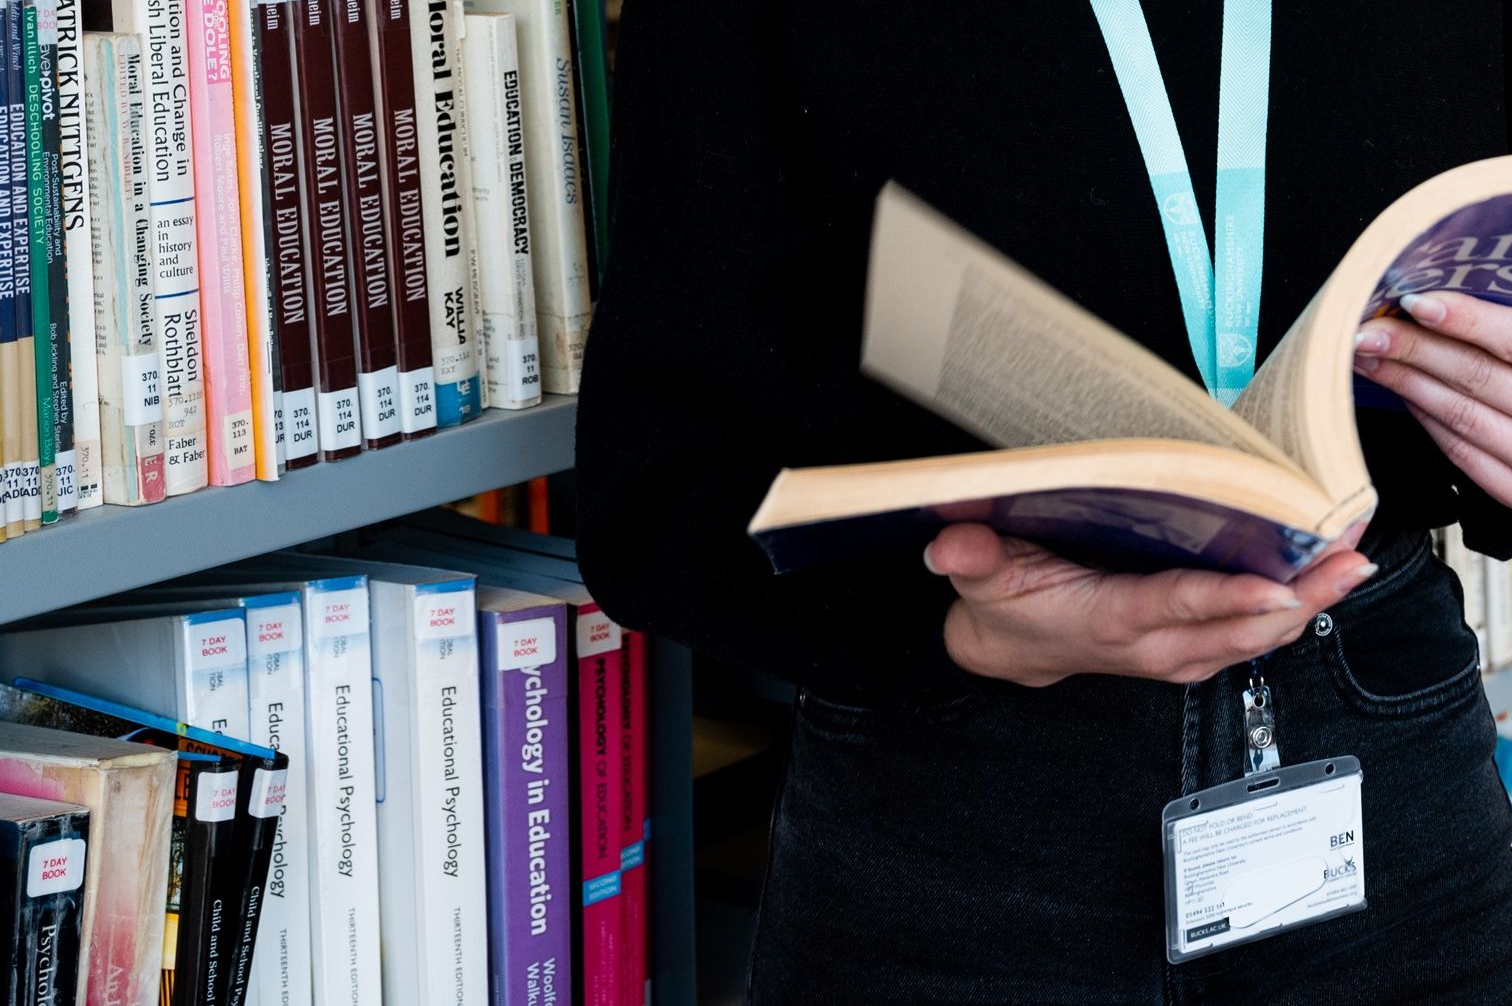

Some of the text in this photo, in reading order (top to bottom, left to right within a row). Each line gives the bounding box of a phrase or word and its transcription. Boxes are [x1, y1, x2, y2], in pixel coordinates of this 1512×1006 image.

[149, 24, 168, 87] Liberal
[171, 44, 182, 78] and
[203, 12, 219, 81] DOLE?
[26, 11, 45, 245] Ivan Illich DESCHOOLING SOCIETY
[173, 84, 187, 152] Change
[503, 69, 523, 157] EDUCATION
[556, 57, 577, 205] Susan Isaacs
[151, 91, 172, 182] Education
[60, 95, 84, 230] NUTTGENS
[176, 159, 188, 177] in
[432, 90, 461, 258] Education
[9, 103, 30, 296] EDUCATION AND EXPERTISE
[127, 54, 153, 348] Moral Education in a Changing Society
[313, 116, 348, 317] MORAL EDUCATION
[353, 111, 388, 309] MORAL EDUCATION
[394, 107, 426, 303] MORAL EDUCATION
[509, 161, 529, 255] DEMOCRACY
[157, 215, 195, 231] an essay
[270, 122, 305, 325] MORAL EDUCATION
[158, 240, 193, 254] history
[159, 255, 180, 266] and
[159, 265, 194, 279] culture
[1224, 214, 1235, 327] BUCKINGHAMSHIRE
[444, 292, 456, 330] KAY
[1235, 304, 1244, 327] NEW
[184, 308, 200, 382] Sheldon
[144, 395, 160, 406] NIB
[378, 409, 396, 422] DUR
[414, 404, 432, 417] DUR
[168, 436, 197, 450] Faber
[293, 430, 313, 444] DUR
[336, 420, 356, 434] DUR
[57, 485, 74, 497] JIC
[258, 631, 284, 643] BOOK
[430, 616, 456, 627] BOOK
[202, 645, 228, 657] BOOK
[513, 646, 538, 657] BOOK
[335, 684, 357, 878] Educational Psychology
[440, 685, 462, 878] Educational Psychology
[521, 665, 552, 936] ychology in Education
[1189, 836, 1198, 844] FEE
[1200, 832, 1214, 841] WILL
[1223, 821, 1253, 834] CHARGED
[1253, 818, 1266, 826] FOR
[1266, 806, 1307, 822] REPLACEMENT
[1208, 820, 1226, 829] FOLD
[1226, 817, 1236, 825] OR
[1236, 813, 1254, 822] BEND
[1330, 830, 1354, 847] BEN
[42, 867, 67, 881] BOOK
[1323, 861, 1357, 879] BUCKS
[236, 886, 260, 986] Child and School
[1190, 923, 1227, 938] BUCKS.AC.UK
[206, 899, 223, 1006] Child and School
[280, 928, 289, 984] THIRTEENTH
